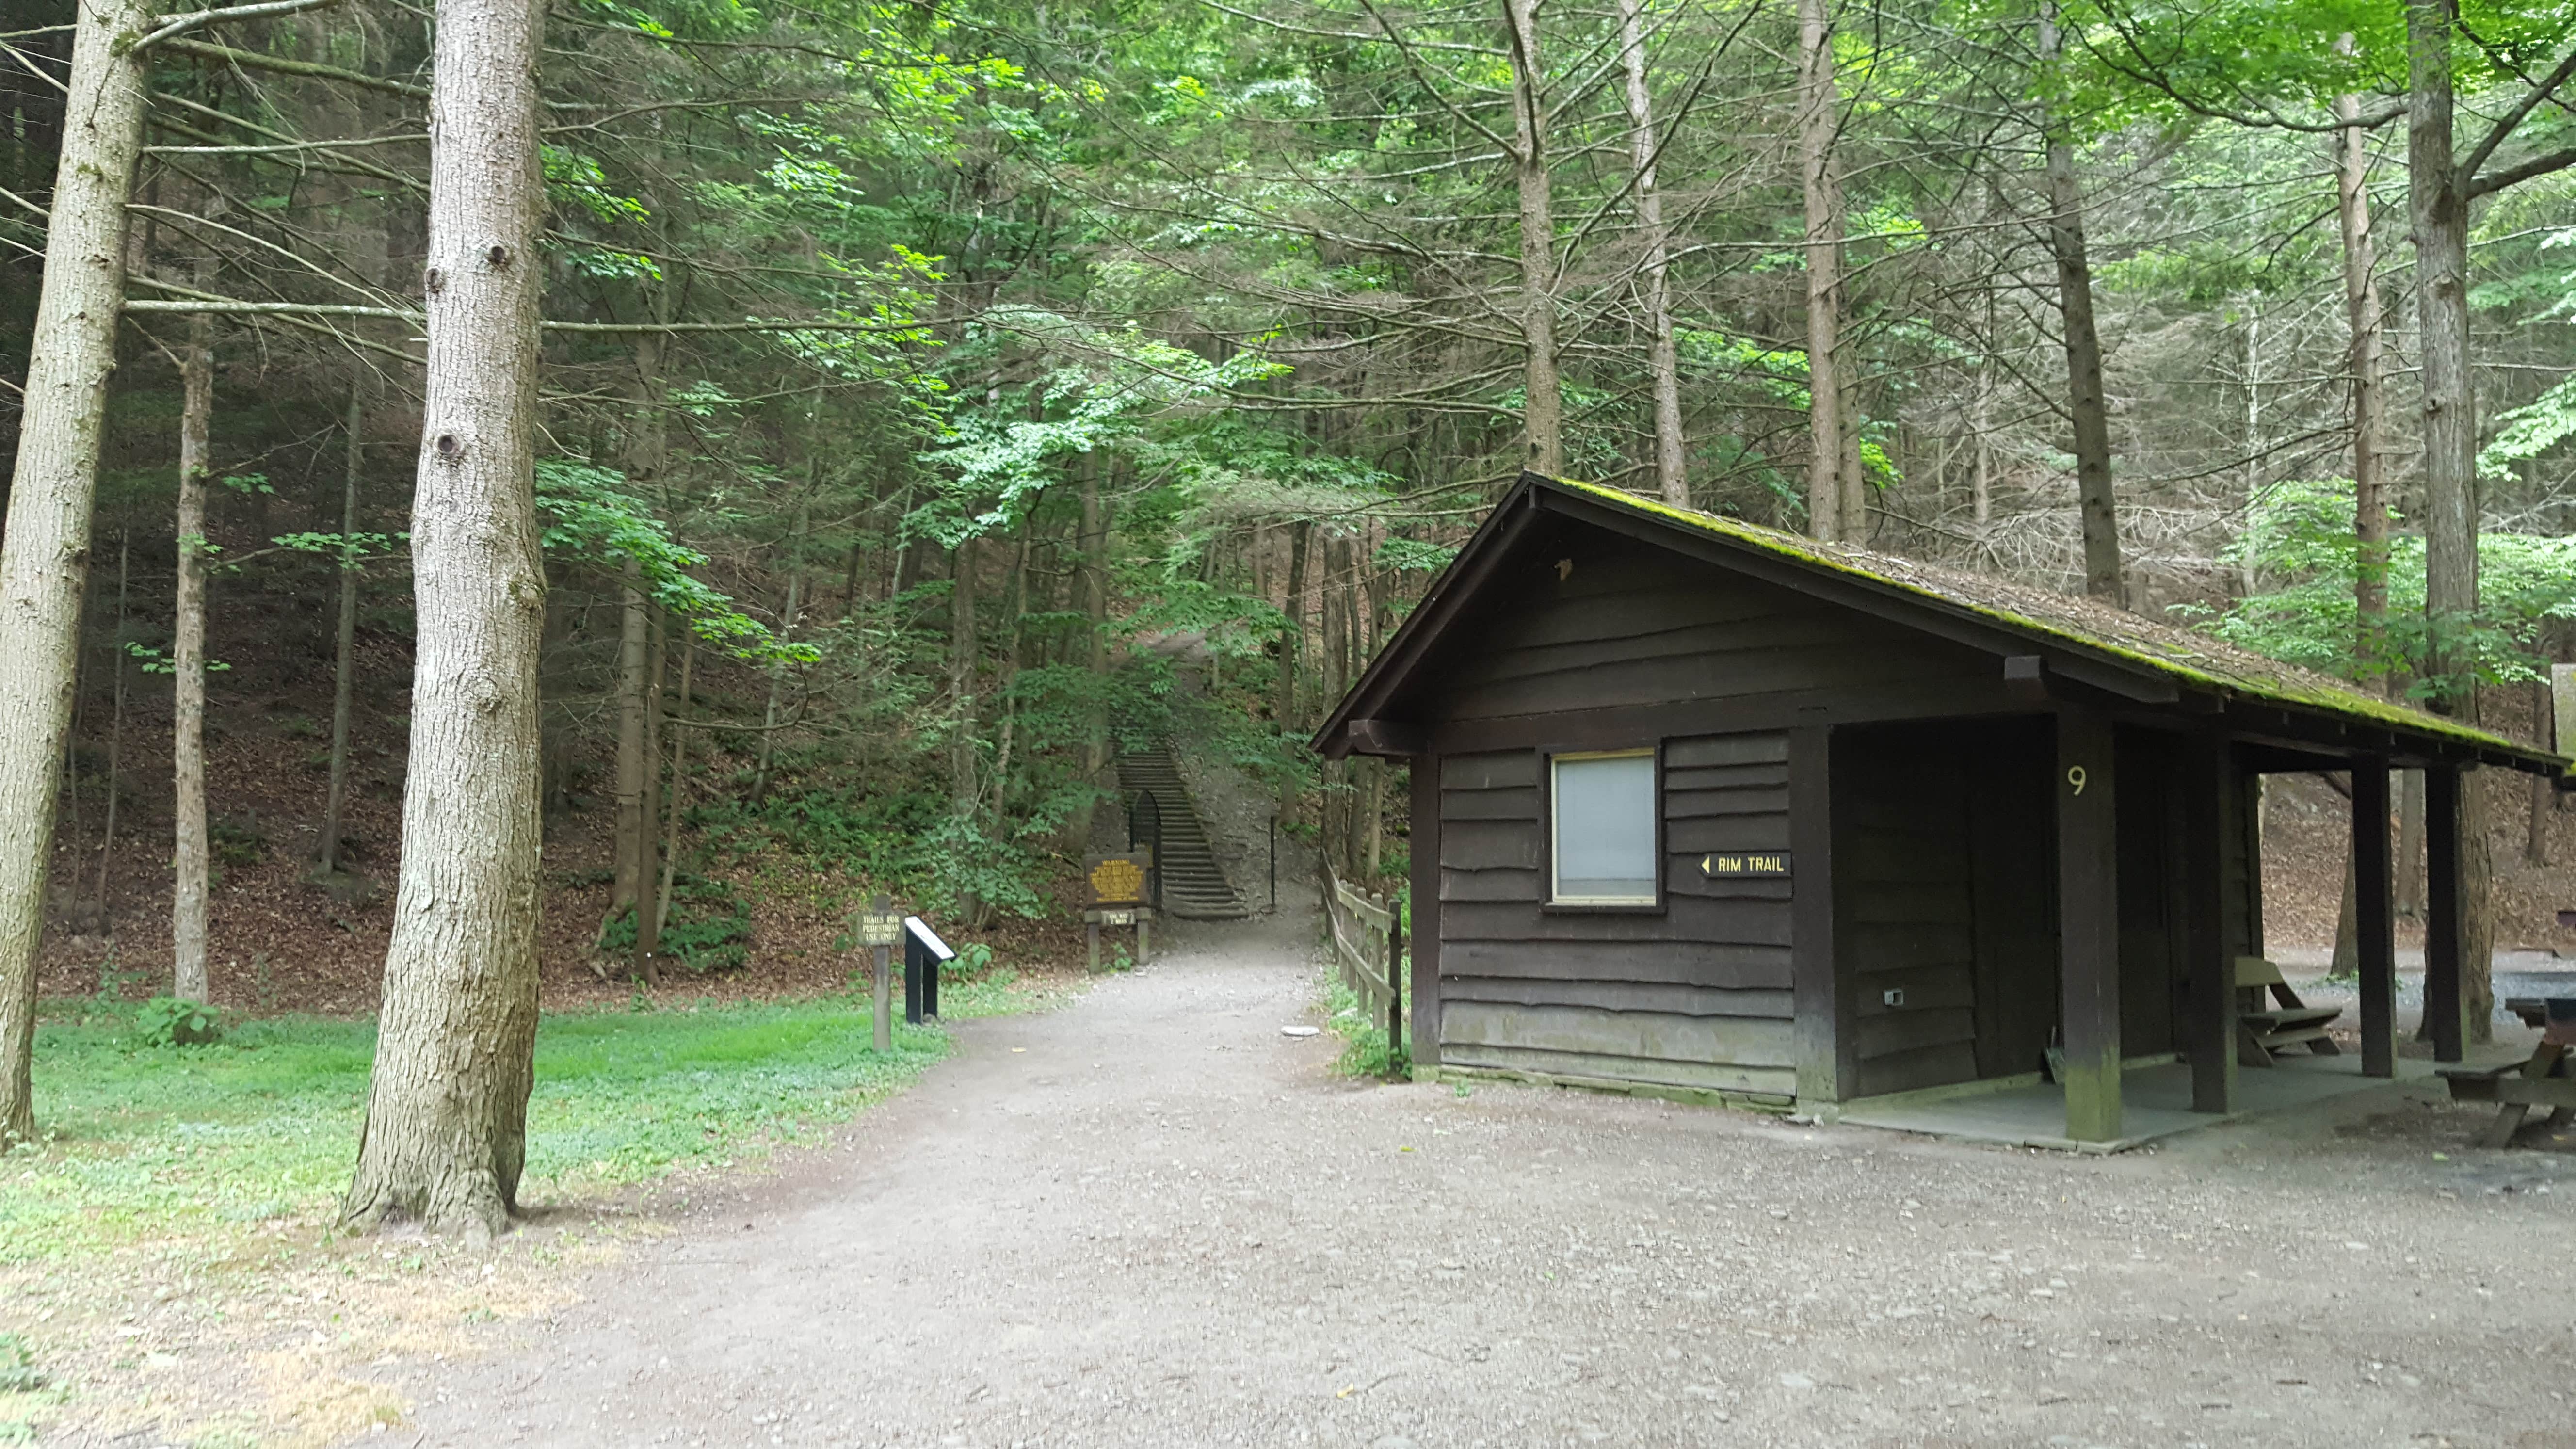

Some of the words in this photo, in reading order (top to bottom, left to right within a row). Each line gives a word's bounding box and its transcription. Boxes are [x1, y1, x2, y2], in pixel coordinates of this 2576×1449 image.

[2068, 765, 2086, 796] 9
[1718, 857, 1741, 872] RIM
[1748, 856, 1784, 872] TRAIL
[863, 915, 884, 923] TRAILS
[887, 915, 899, 923] FOR
[863, 923, 900, 932] PEDESTRIAN
[866, 932, 877, 941] USE
[881, 932, 896, 940] ONLY
